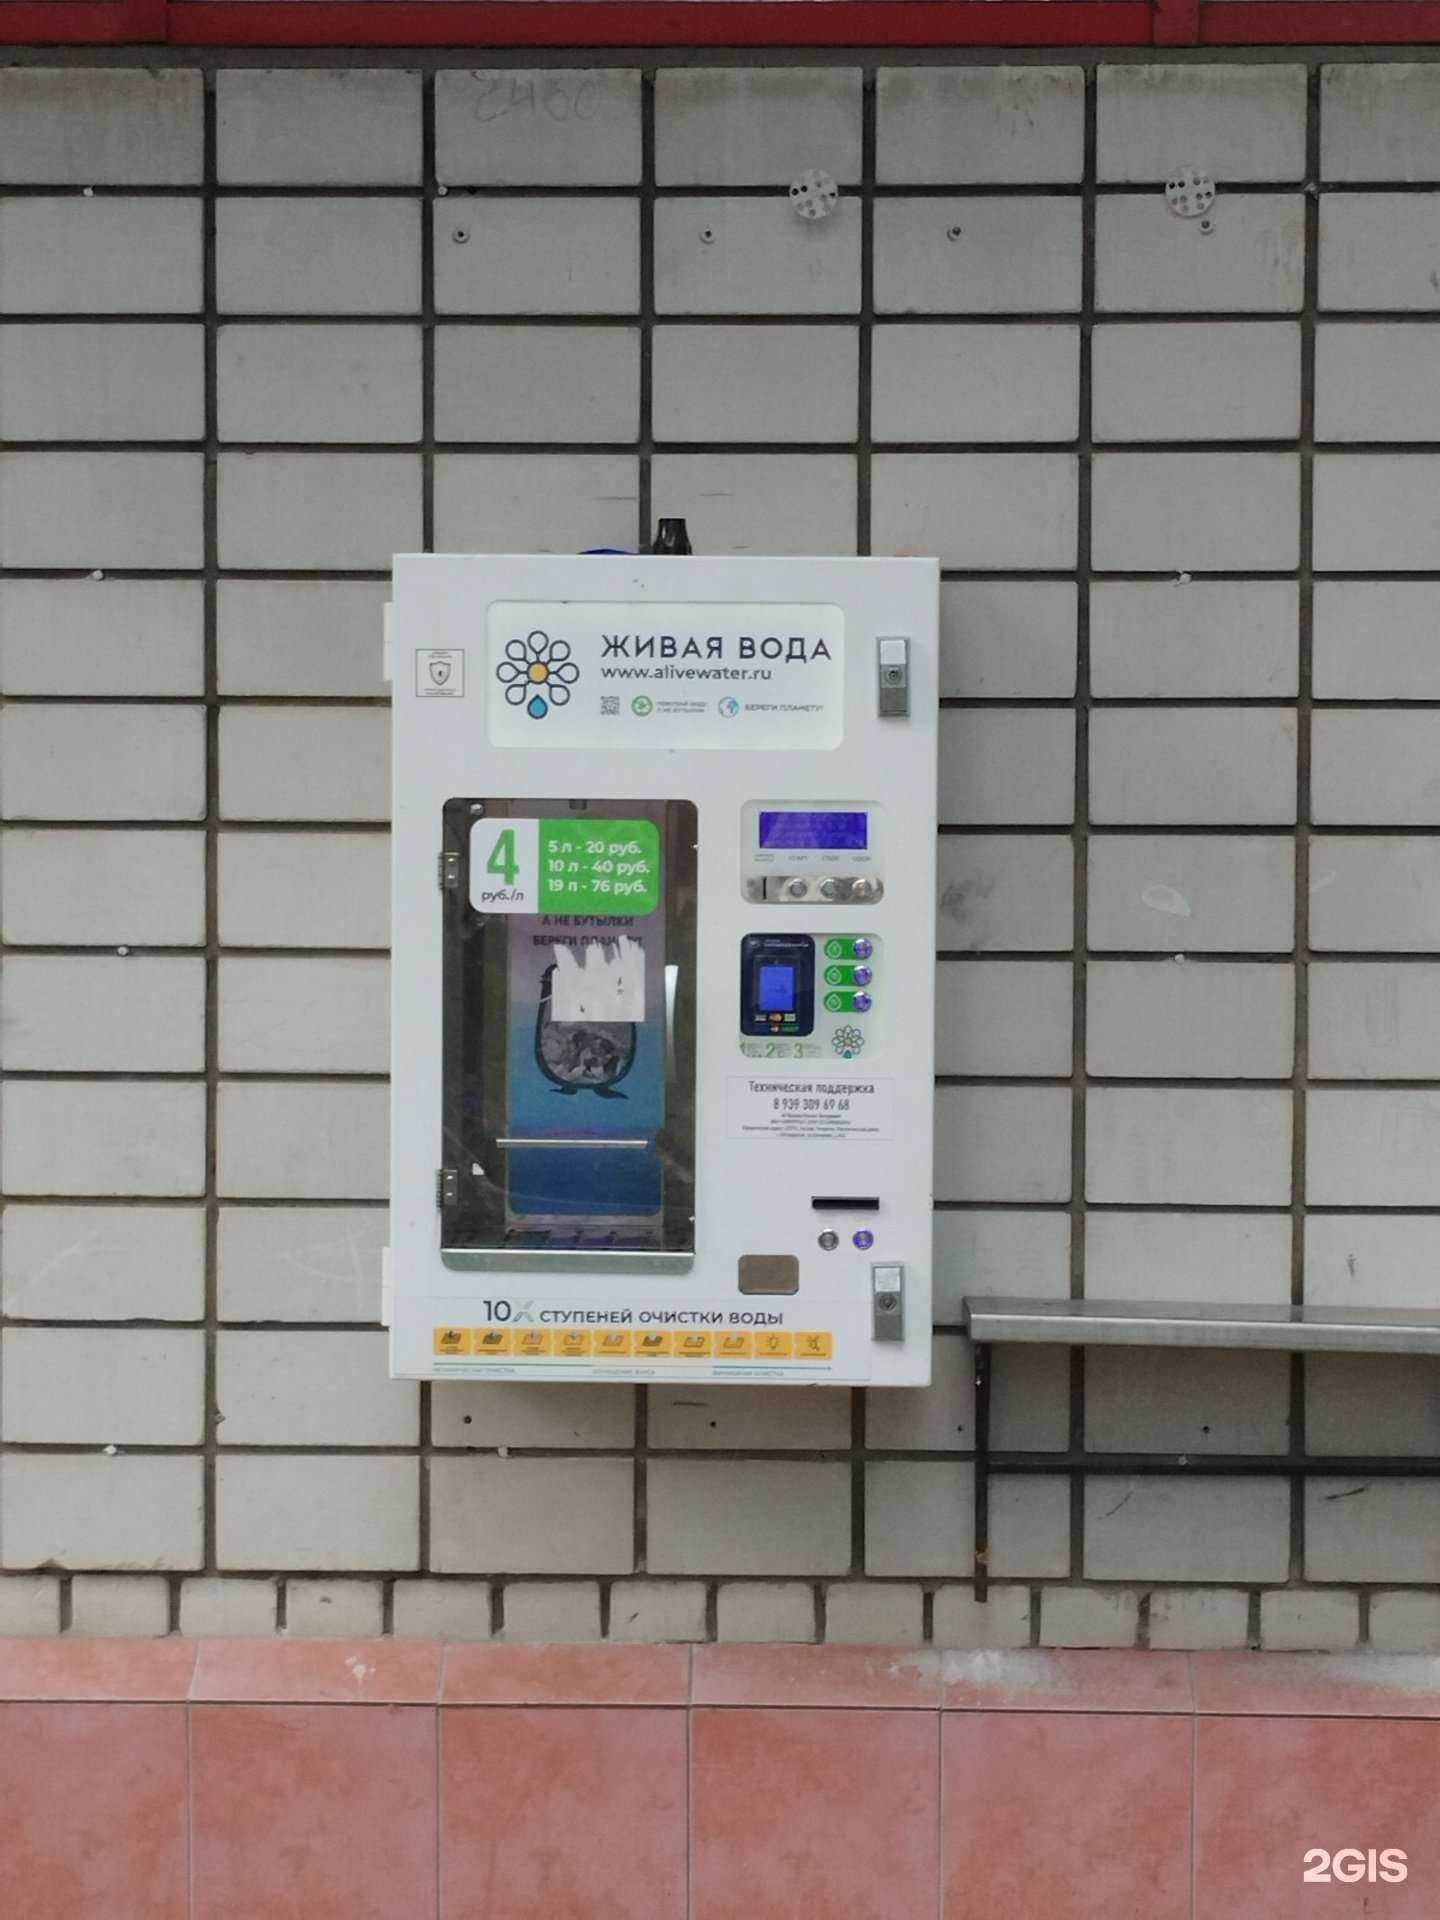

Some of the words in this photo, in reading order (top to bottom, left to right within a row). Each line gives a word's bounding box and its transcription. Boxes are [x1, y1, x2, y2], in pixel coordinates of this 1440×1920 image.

[601, 634, 724, 659] ЖИВАЯ
[738, 636, 832, 664] ВОДА
[601, 664, 773, 681] www.alivewater.ru
[486, 828, 520, 886] 4
[547, 841, 558, 853] 5
[559, 842, 573, 853] л
[585, 841, 605, 853] 20
[608, 841, 643, 858] руб.
[547, 860, 564, 872] 10
[567, 861, 579, 872] л
[591, 860, 613, 873] 40
[617, 861, 650, 877] руб.
[481, 888, 525, 902] руб./л
[547, 879, 564, 891] 19
[567, 880, 579, 891] л
[591, 879, 612, 892] 76
[614, 880, 648, 896] руб.
[541, 915, 551, 926] А
[554, 915, 570, 926] НЕ
[573, 915, 634, 927] БУТЫЛКИ
[748, 1080, 813, 1093] Техническая
[815, 1083, 875, 1097] поддержка
[773, 1098, 780, 1110] 8
[782, 1098, 800, 1110] 939
[802, 1098, 820, 1110] 309
[823, 1098, 835, 1110] 69
[838, 1099, 850, 1111] 68
[539, 1307, 634, 1324] СТУПЕНЕЙ
[639, 1310, 724, 1325] ОЧИСТКИ
[728, 1312, 784, 1325] ВОДЫ
